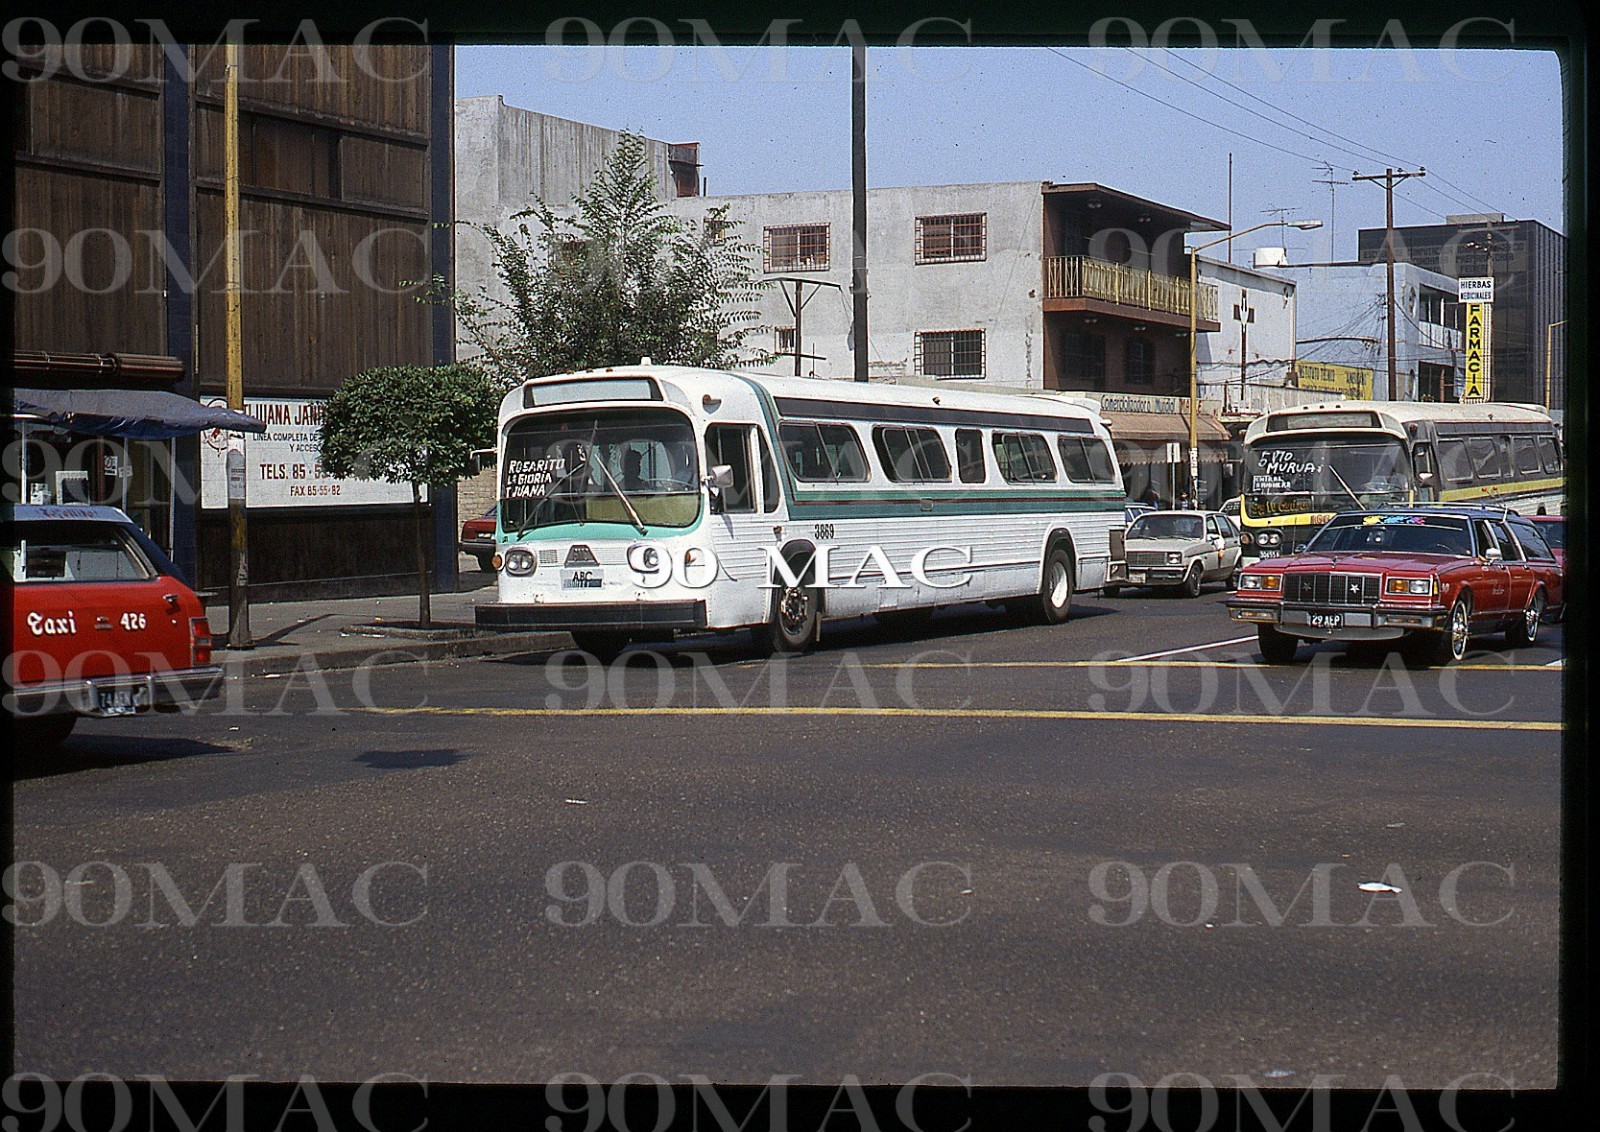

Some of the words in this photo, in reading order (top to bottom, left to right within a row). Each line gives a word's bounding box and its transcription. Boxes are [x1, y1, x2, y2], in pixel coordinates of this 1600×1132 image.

[1461, 281, 1492, 289] HIERBAS
[1468, 304, 1481, 396] FARMACIA
[273, 433, 307, 441] COMPLETA
[289, 443, 295, 452] Y
[508, 455, 565, 474] ROSARITO
[260, 463, 288, 479] TELS.
[290, 486, 305, 496] FAX
[572, 571, 593, 582] ABC
[27, 611, 77, 636] Taxi
[119, 612, 146, 631] 426
